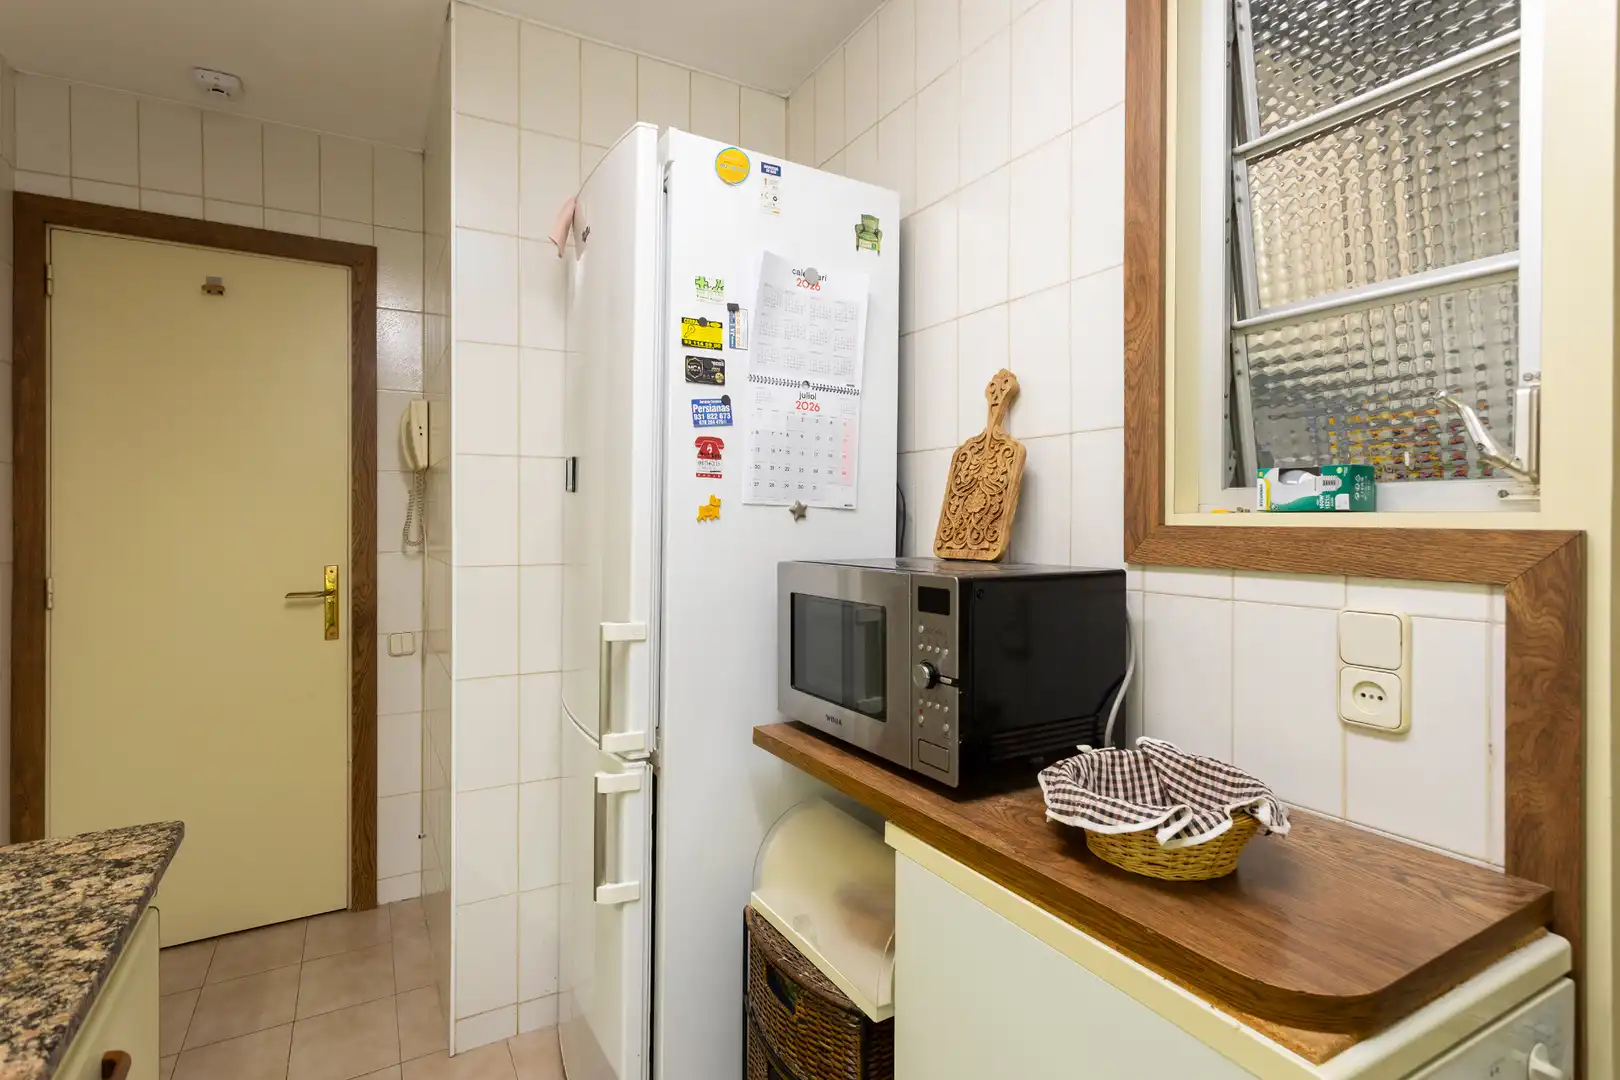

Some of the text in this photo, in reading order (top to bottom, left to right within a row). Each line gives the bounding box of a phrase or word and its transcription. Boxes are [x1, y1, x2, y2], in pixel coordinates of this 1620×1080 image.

[692, 404, 731, 413] Persianas
[795, 400, 821, 412] 2026
[693, 413, 705, 421] 931
